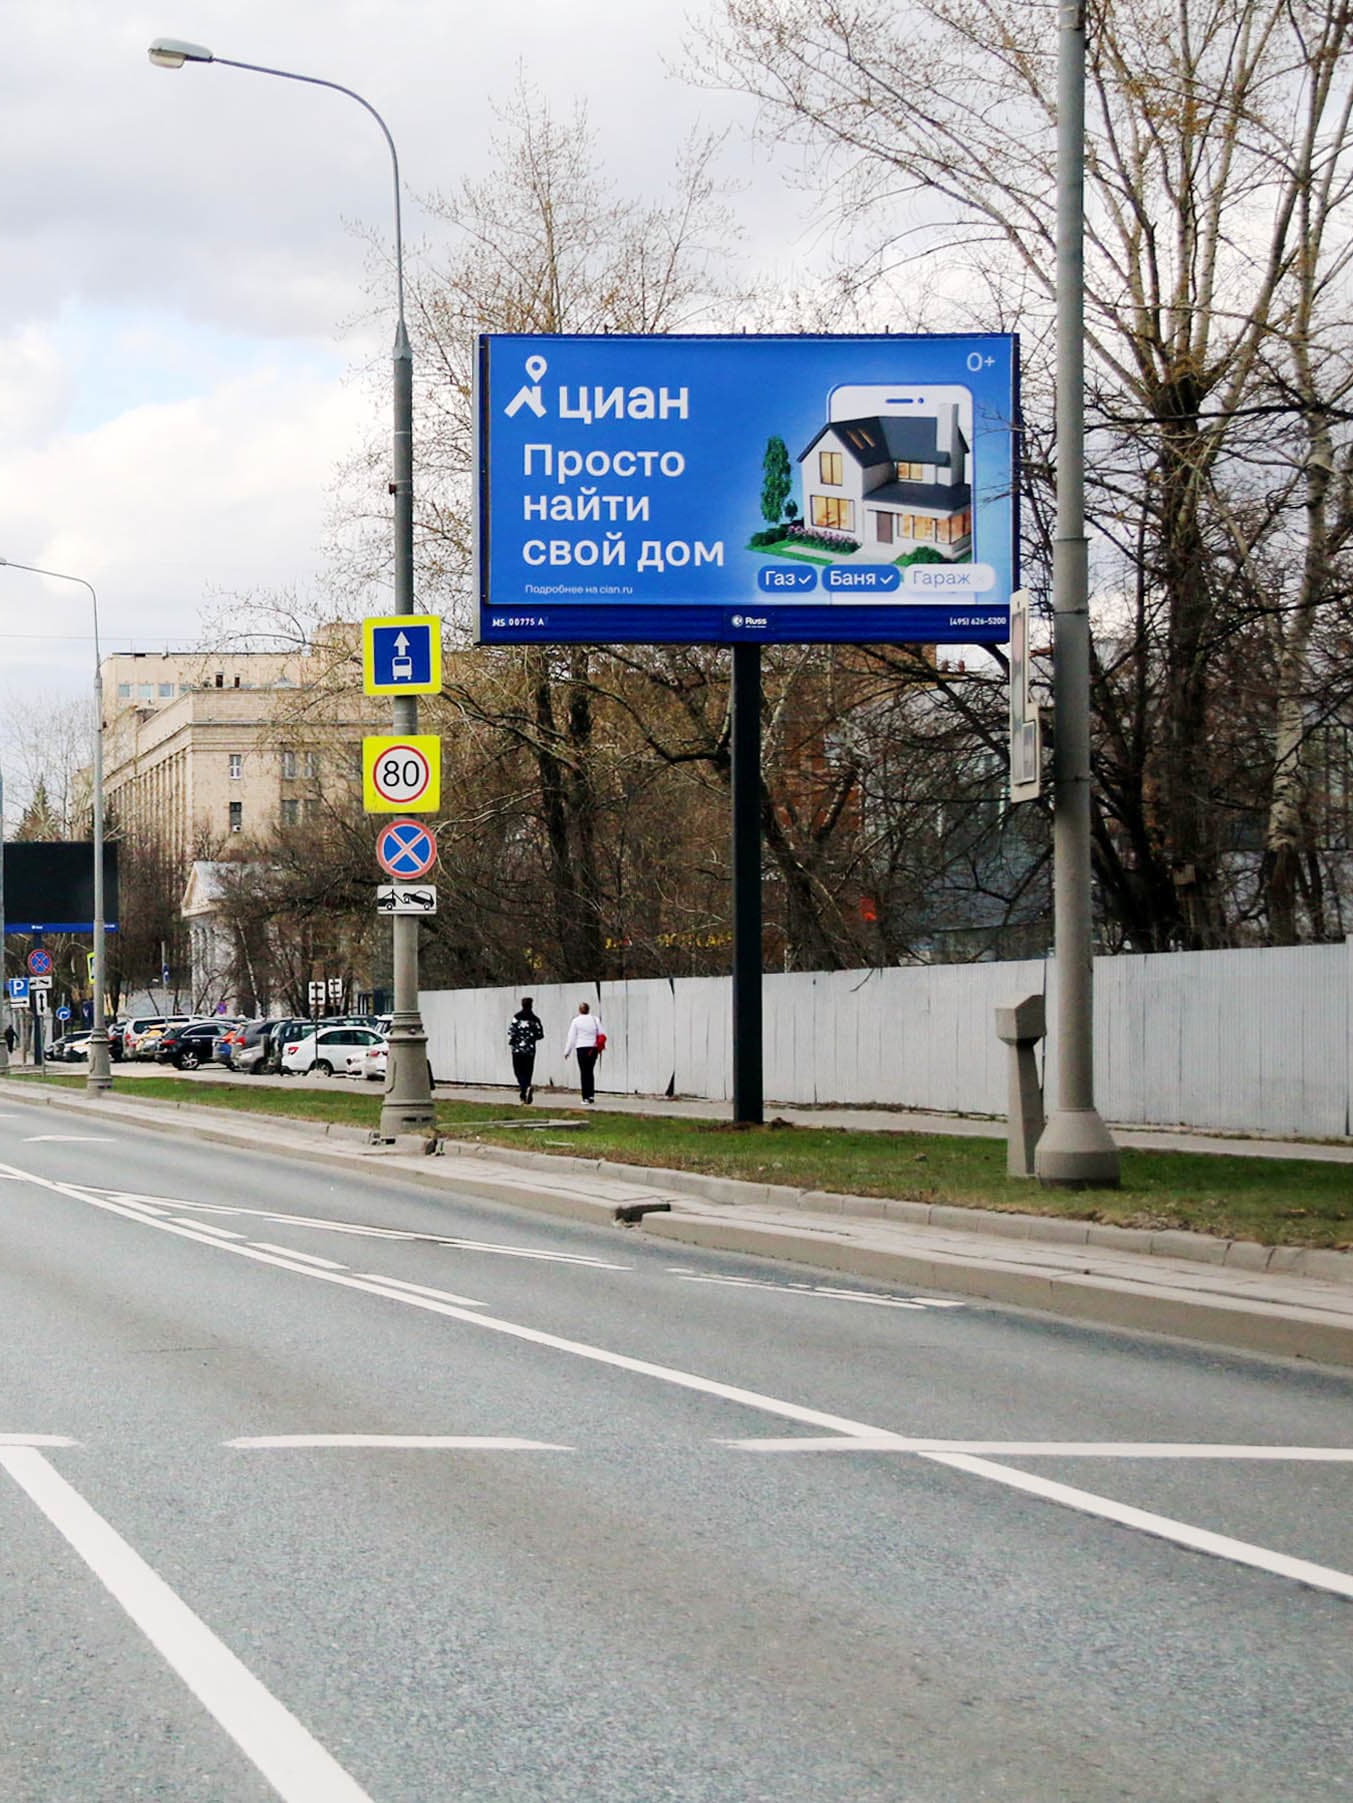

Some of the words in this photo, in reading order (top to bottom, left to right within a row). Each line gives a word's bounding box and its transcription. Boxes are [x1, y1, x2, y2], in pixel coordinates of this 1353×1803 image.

[966, 352, 996, 372] 0+
[523, 444, 685, 484] Просто
[523, 487, 649, 521] найти
[523, 532, 626, 566] свой
[637, 539, 724, 573] дом
[525, 584, 584, 595] Подробнее
[585, 586, 598, 594] на
[599, 584, 633, 594] cian.ru
[765, 570, 795, 586] Газ
[830, 570, 876, 586] Баня
[913, 570, 971, 587] Гараж
[383, 760, 420, 787] 80
[13, 981, 24, 995] P
